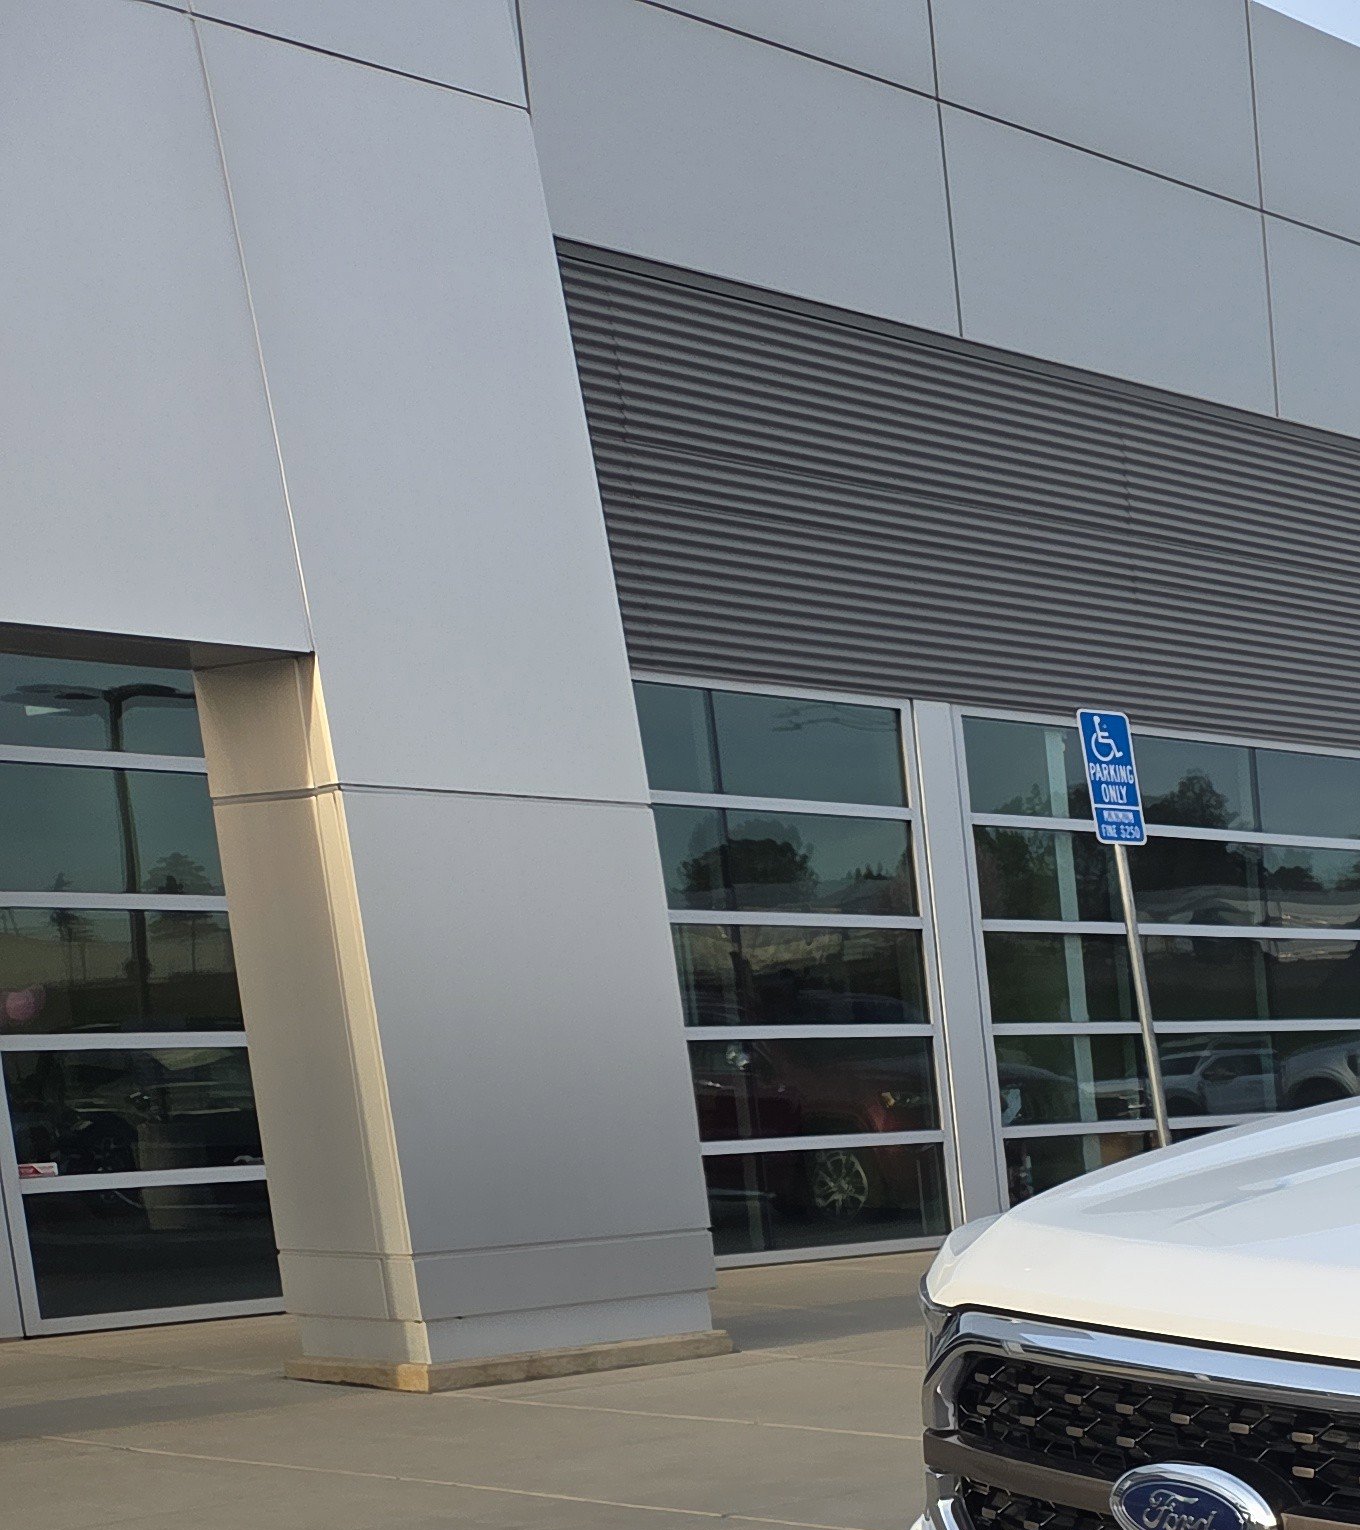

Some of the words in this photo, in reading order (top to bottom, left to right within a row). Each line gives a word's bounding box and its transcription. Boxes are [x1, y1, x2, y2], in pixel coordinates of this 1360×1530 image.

[1089, 762, 1135, 784] PARKING
[1101, 784, 1127, 804] ONLY
[1101, 823, 1118, 838] FINE
[1119, 825, 1140, 839] $250
